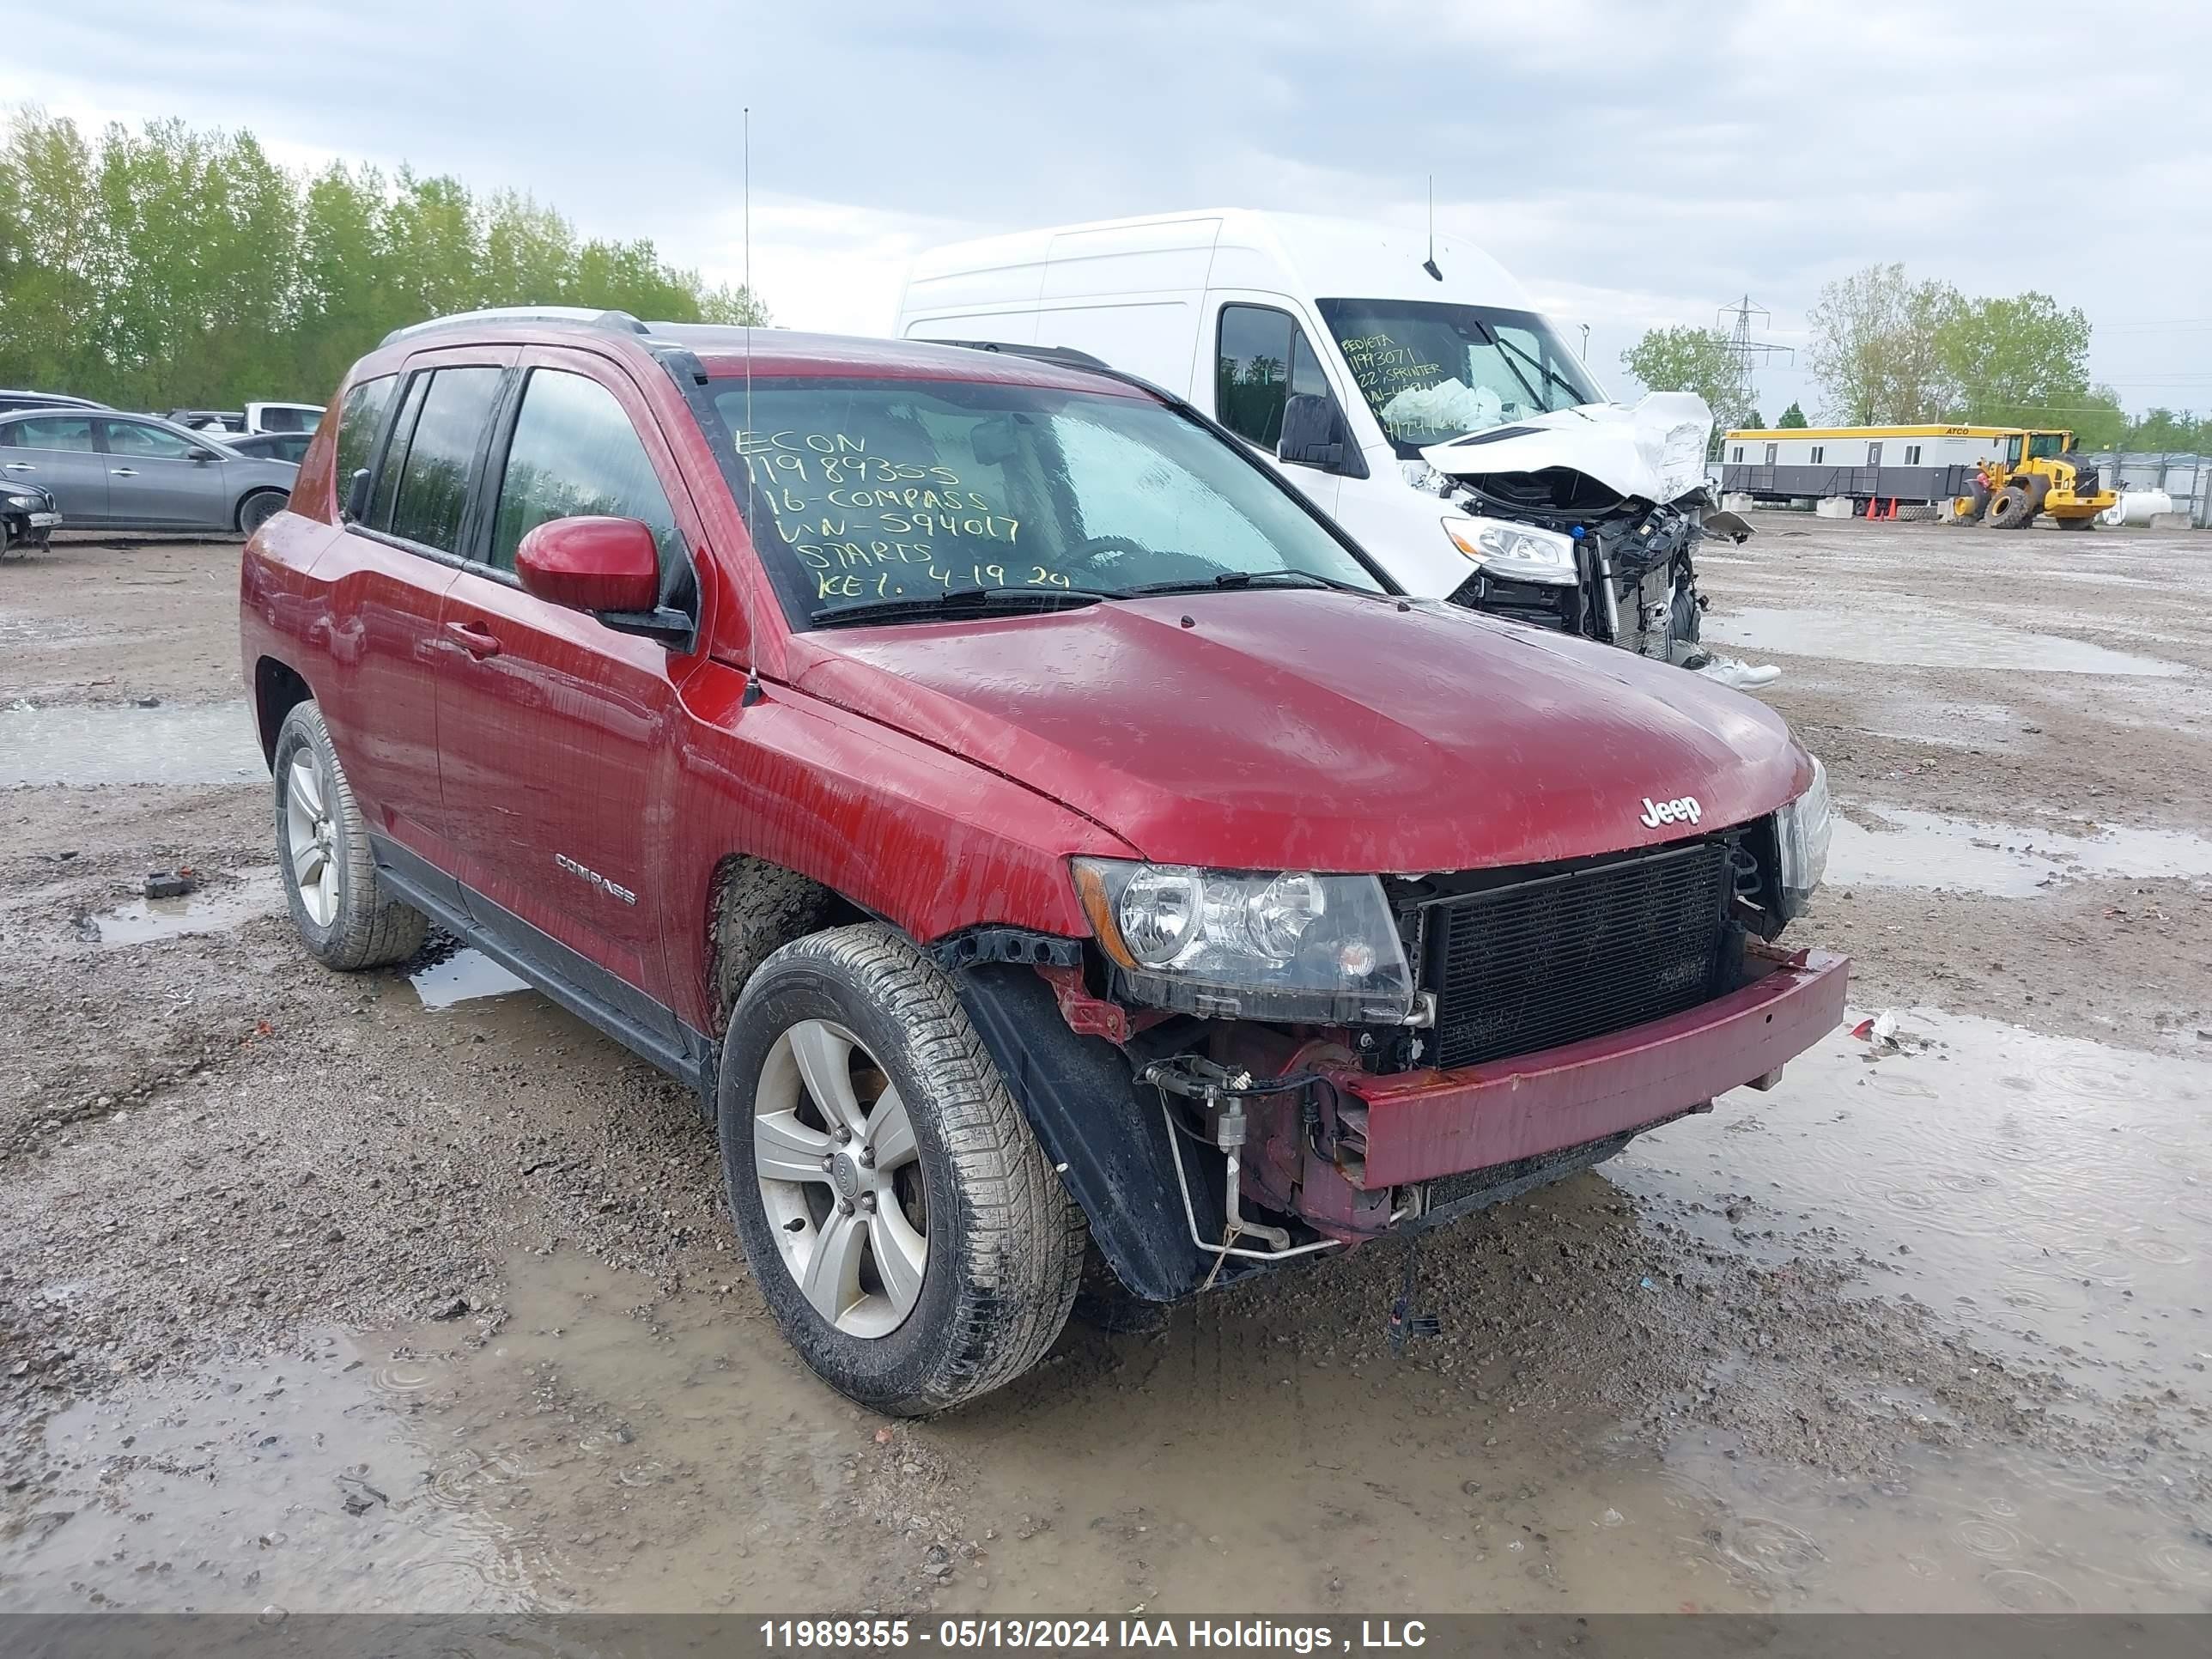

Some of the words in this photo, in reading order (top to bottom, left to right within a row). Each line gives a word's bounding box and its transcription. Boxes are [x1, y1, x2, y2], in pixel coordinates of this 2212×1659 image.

[735, 430, 866, 454] ECON
[1639, 795, 1702, 830] Jeep
[555, 853, 637, 906] COMPASS
